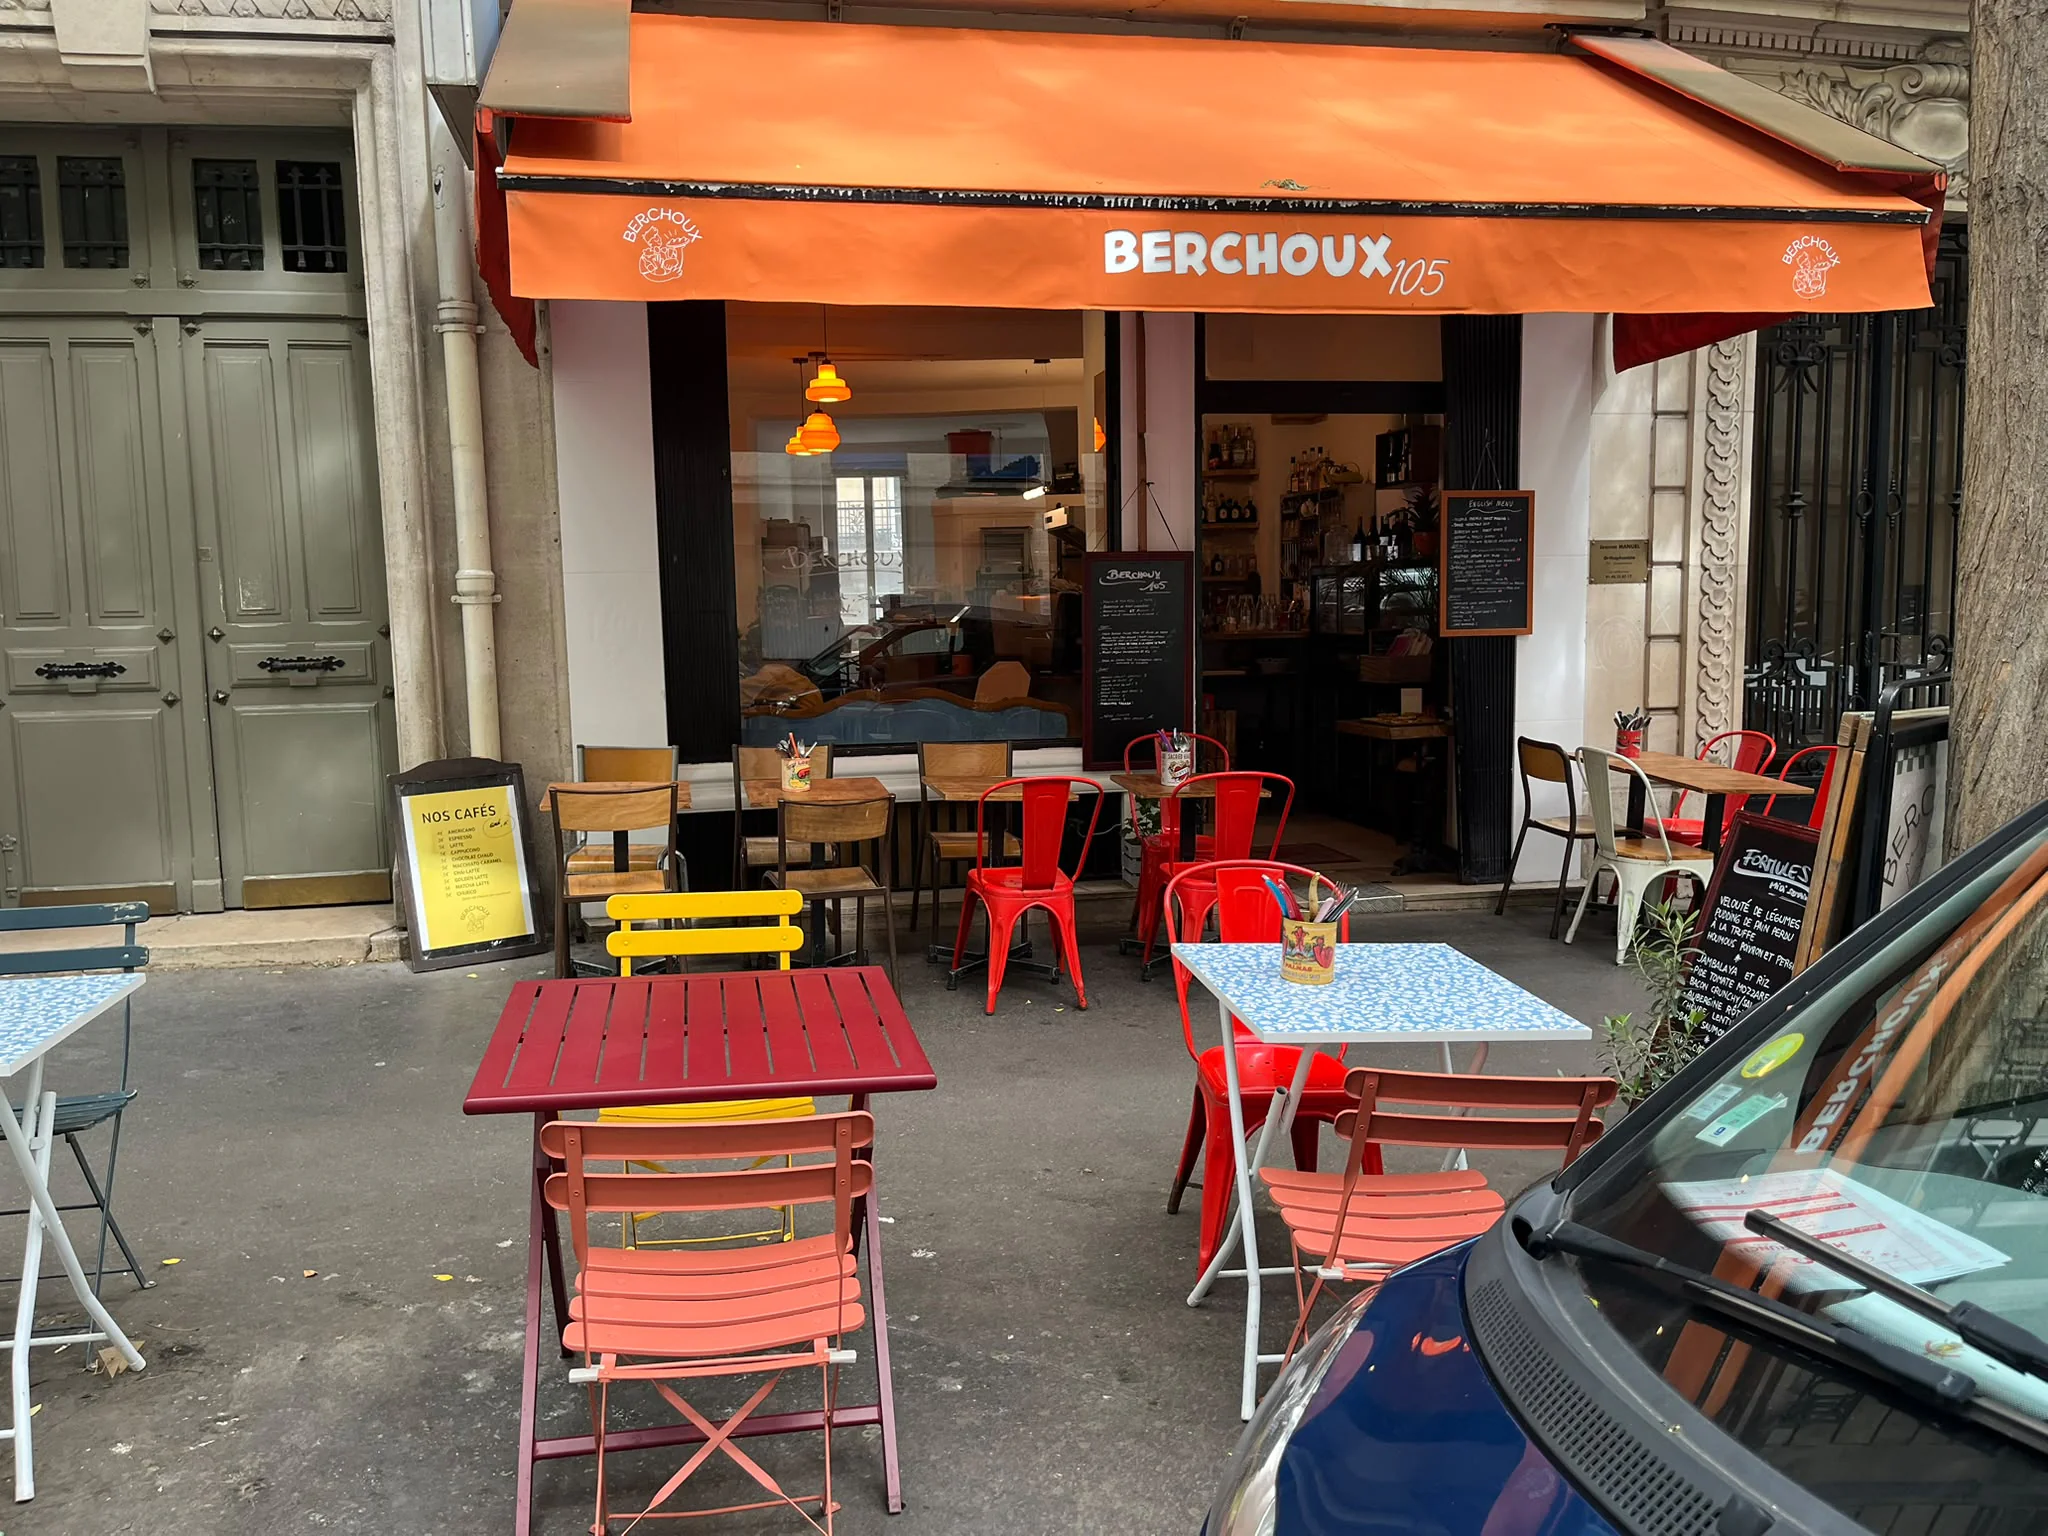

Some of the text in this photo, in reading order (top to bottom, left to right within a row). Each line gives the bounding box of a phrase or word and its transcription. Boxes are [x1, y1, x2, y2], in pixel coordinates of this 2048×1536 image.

[623, 207, 703, 243] BERCHOUX
[1781, 235, 1840, 267] BERCHOUX
[1104, 229, 1451, 296] BERCHOUX 105
[422, 803, 496, 824] NOS CAFÉS
[448, 827, 476, 835] AMERICANO
[449, 834, 472, 842] ESPRESSO
[452, 854, 477, 862] CHOCOLAT
[1720, 895, 1802, 930] VELOUTÉ DE LÉGUMES
[1706, 931, 1738, 948] HOUMOUS
[1710, 917, 1757, 942] À LA TRUFFE
[1743, 916, 1753, 928] DE
[1771, 926, 1795, 942] PERDU
[1696, 954, 1738, 976] JAMBALAYA
[1744, 971, 1755, 981] ET
[1689, 976, 1709, 991] BACON
[1709, 971, 1735, 989] TOMATE
[1725, 1004, 1744, 1018] RÔT
